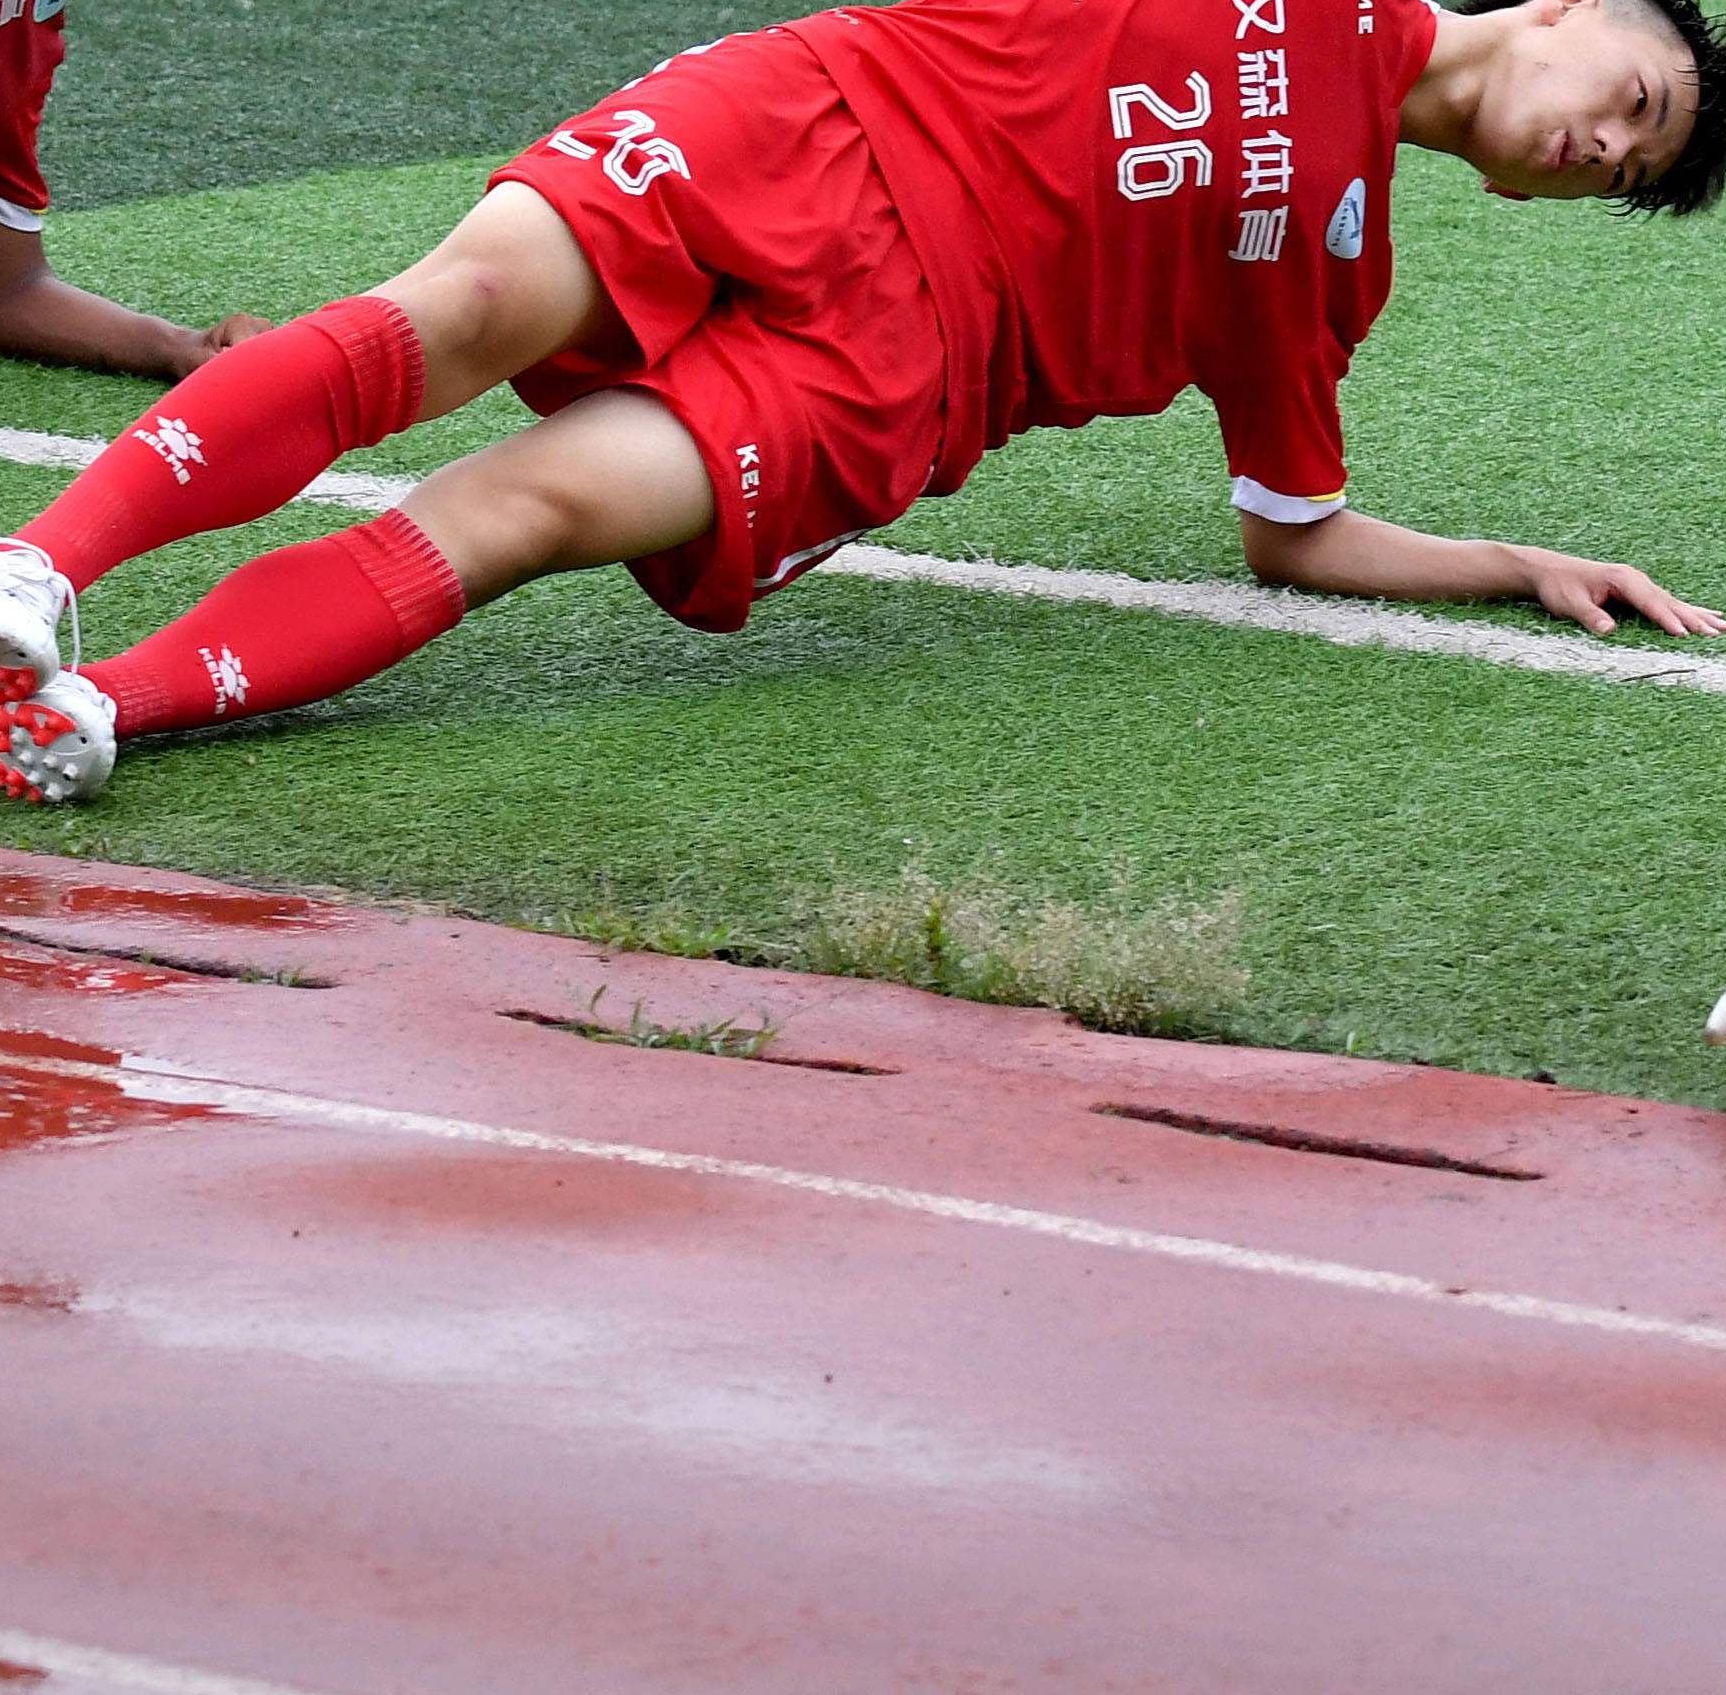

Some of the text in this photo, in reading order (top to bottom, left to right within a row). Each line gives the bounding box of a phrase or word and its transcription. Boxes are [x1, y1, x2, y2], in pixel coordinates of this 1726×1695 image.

[1107, 69, 1214, 203] 26
[131, 428, 192, 485] KELME
[197, 647, 227, 715] KELME
